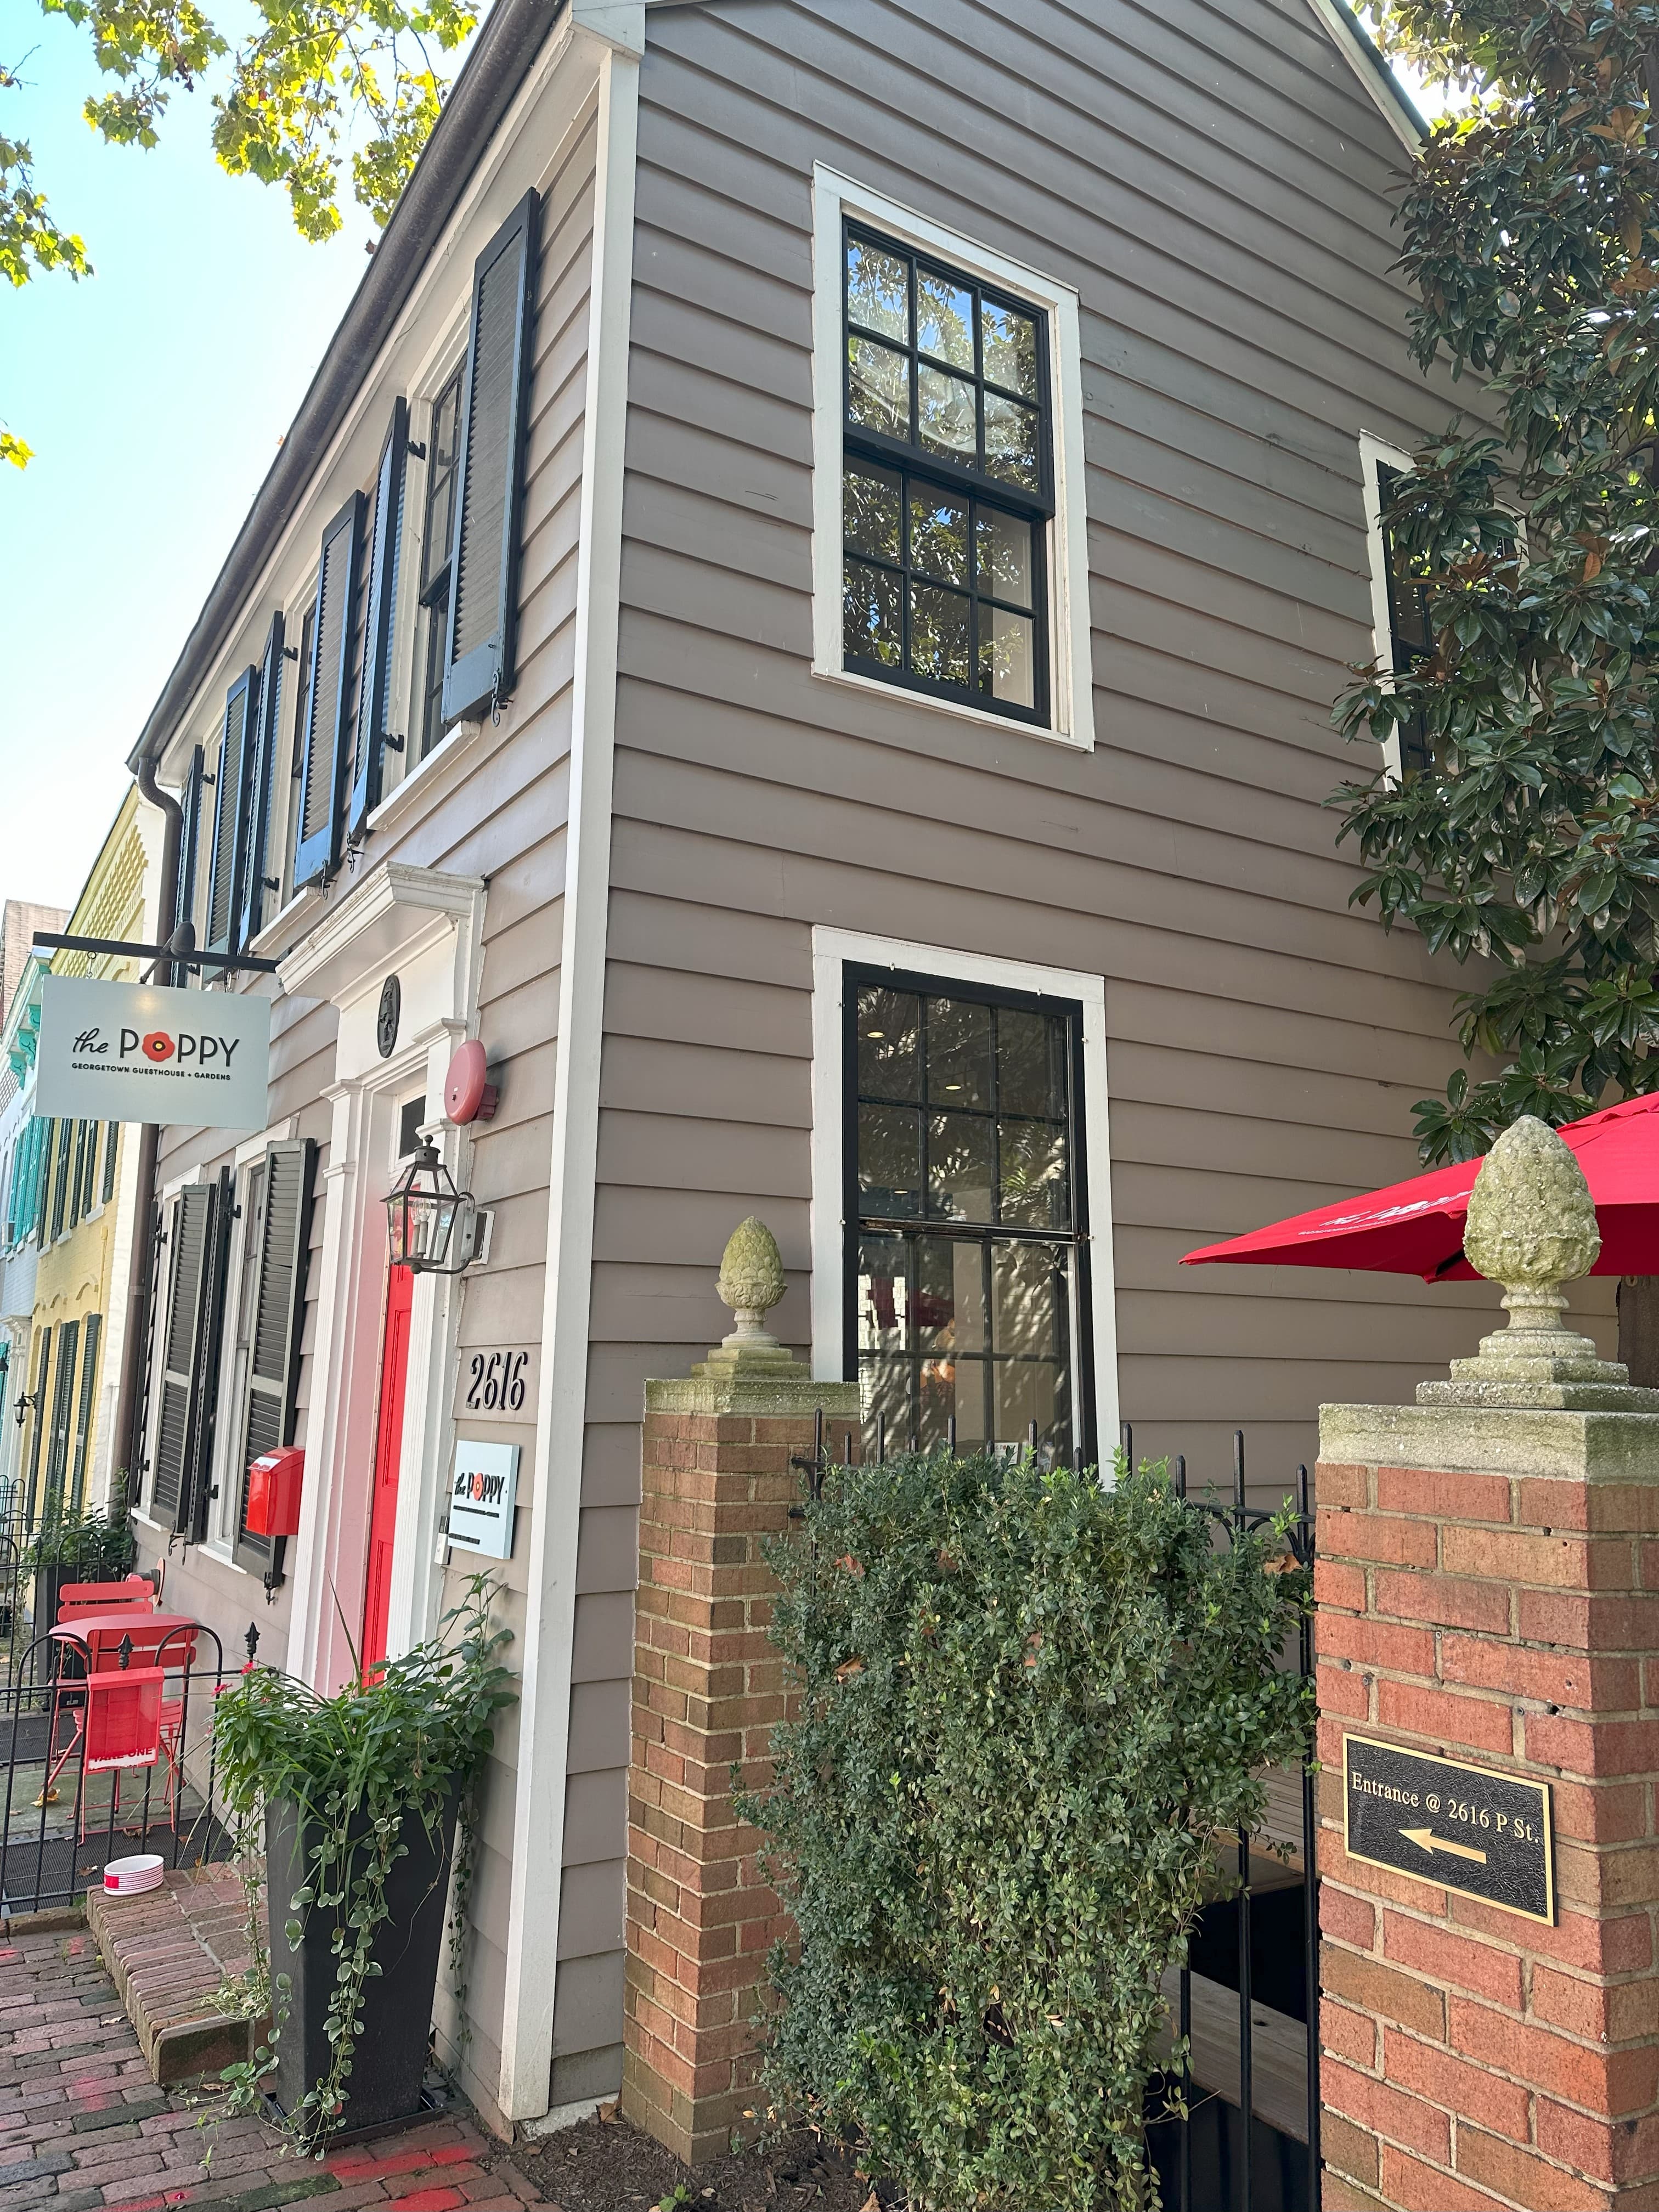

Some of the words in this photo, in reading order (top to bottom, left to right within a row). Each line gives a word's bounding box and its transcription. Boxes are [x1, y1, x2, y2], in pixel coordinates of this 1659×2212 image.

[72, 1028, 109, 1053] the
[71, 1063, 129, 1073] GEORGETOWN
[132, 1067, 185, 1077] GUESTHOUSE
[465, 1351, 528, 1411] 2616
[454, 1472, 466, 1496] the
[1351, 1771, 1420, 1808] Entrance
[1425, 1793, 1441, 1814] @
[1448, 1799, 1490, 1829] 2616
[1496, 1813, 1508, 1833] P
[1514, 1819, 1539, 1843] St.
